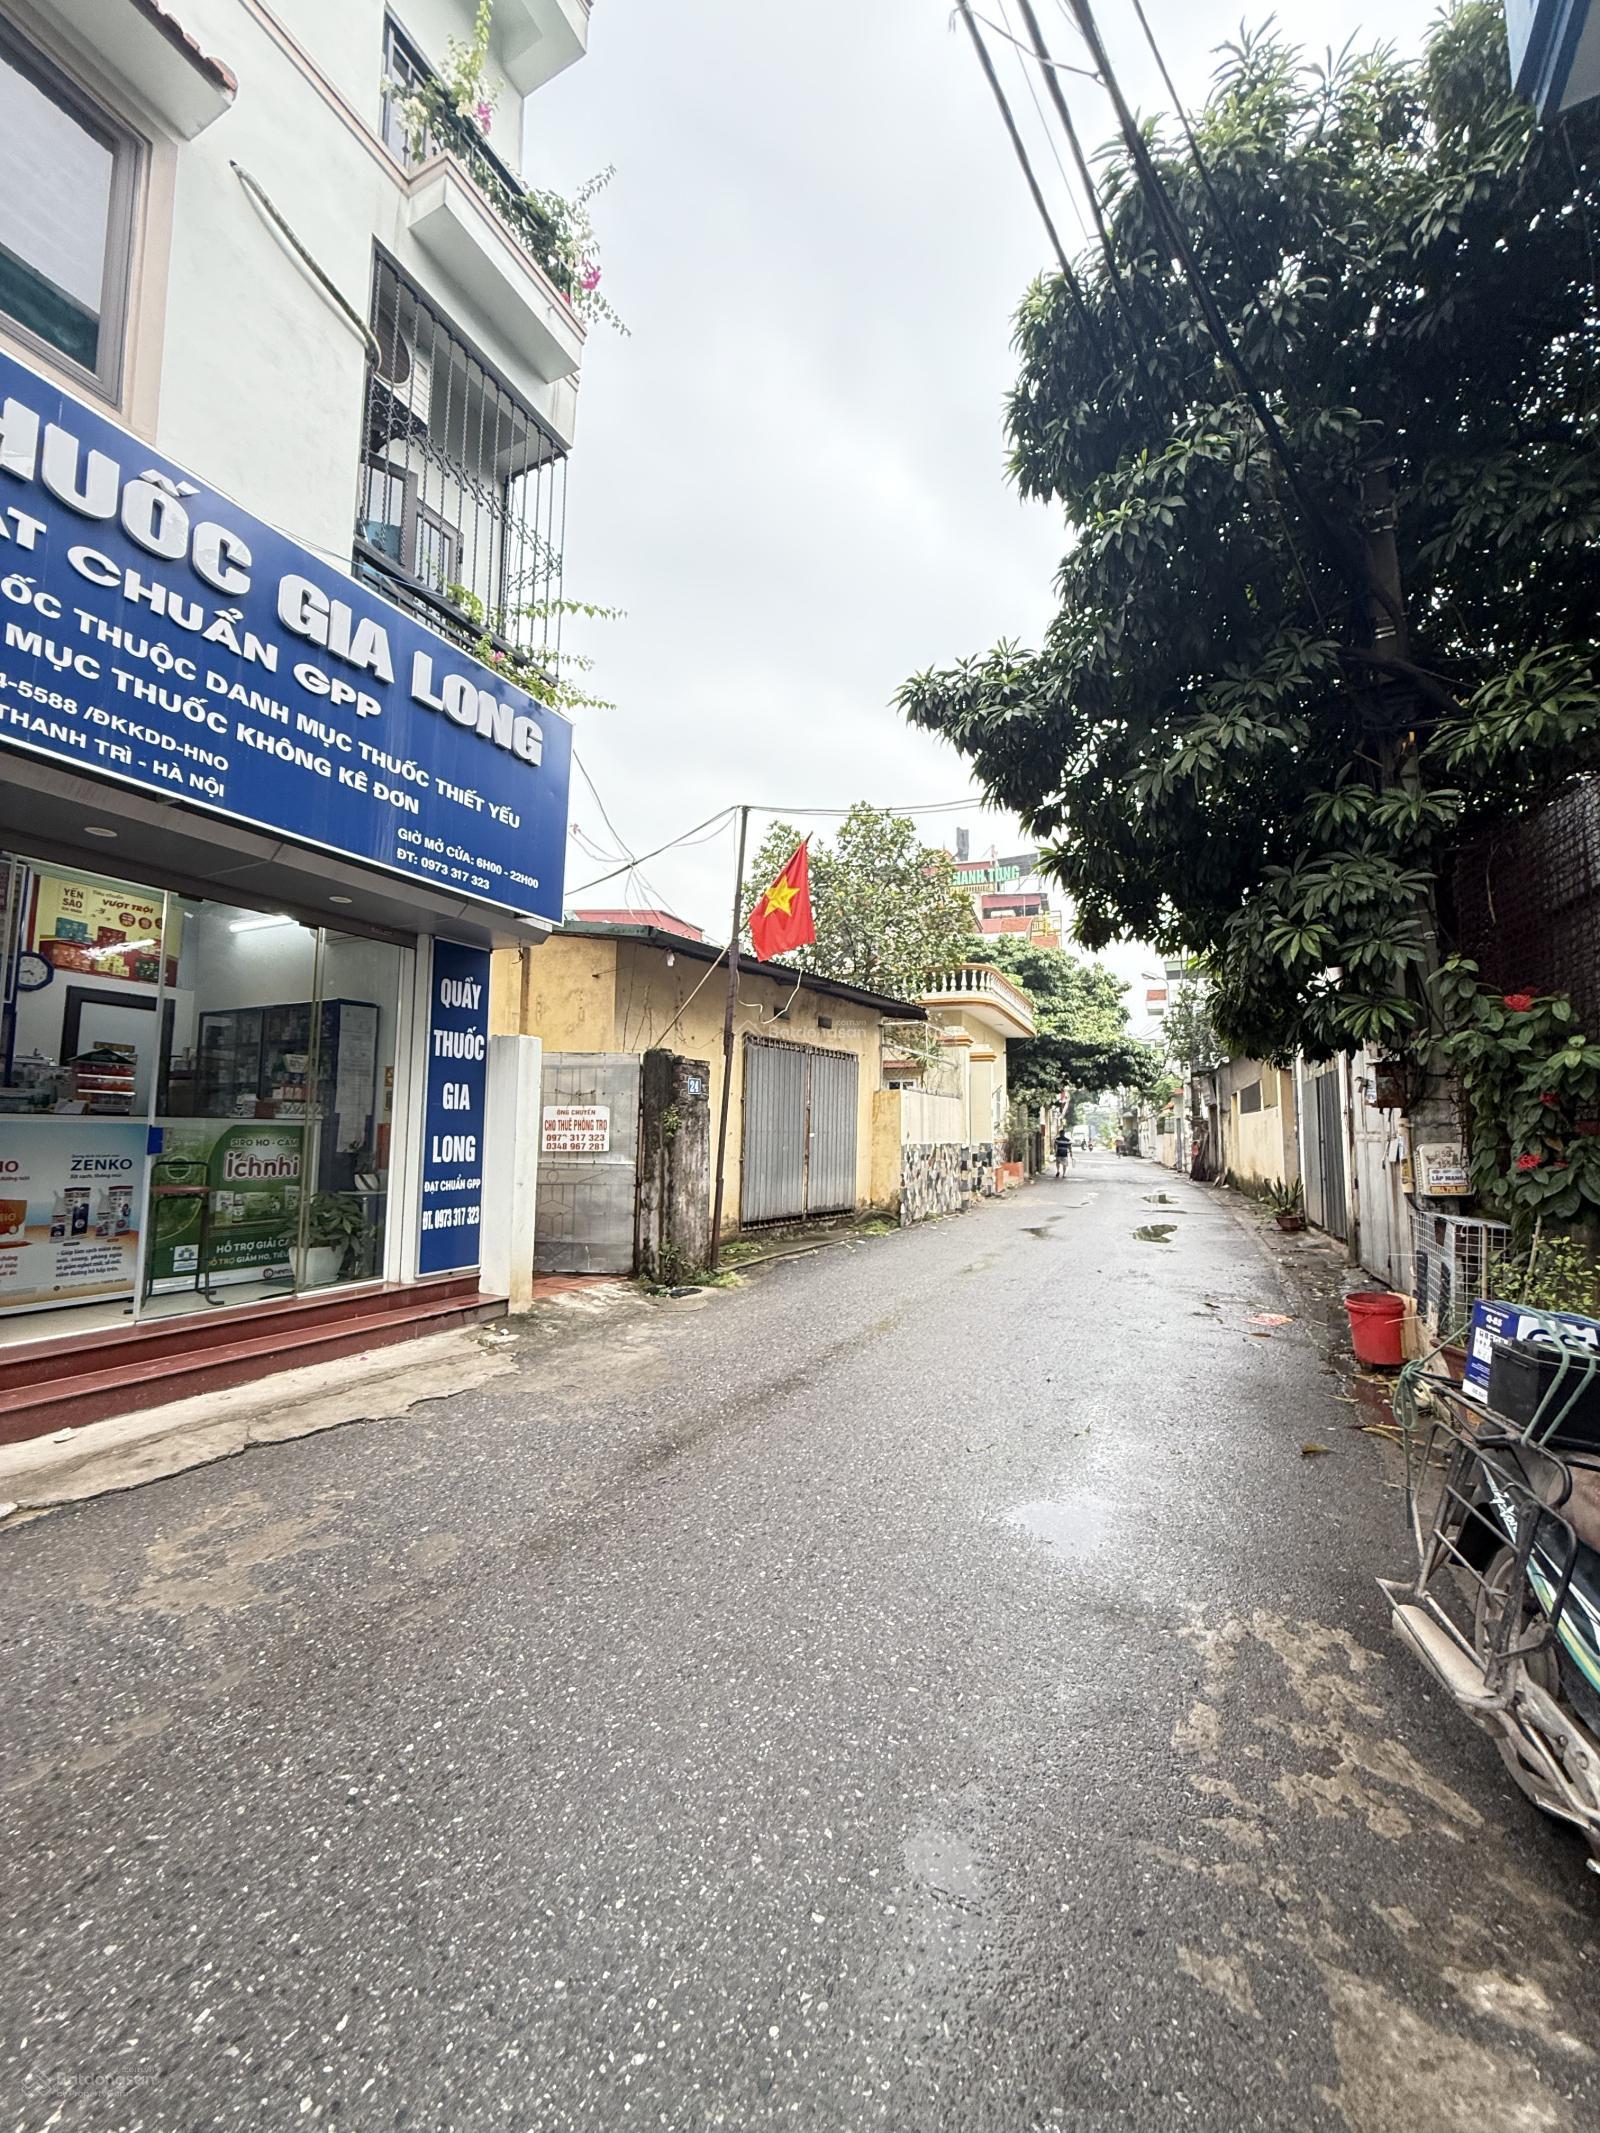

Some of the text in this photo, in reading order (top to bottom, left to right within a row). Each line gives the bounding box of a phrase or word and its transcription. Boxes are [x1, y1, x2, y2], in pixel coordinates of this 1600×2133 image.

[67, 546, 278, 672] CHUẨN
[293, 663, 381, 718] GPP
[278, 574, 394, 684] GIA
[411, 651, 543, 767] LONG
[5, 622, 419, 815] MỤC THUỐC KHÔNG KÊ ĐƠN
[73, 608, 196, 680] THUỘC
[206, 670, 289, 724] DANH
[297, 713, 352, 752] MỤC
[358, 741, 429, 787] THUỐC
[435, 778, 485, 812] THIẾT
[488, 803, 521, 829] YẾU
[94, 738, 132, 765] TRÌ
[152, 759, 183, 783] HÀ
[189, 777, 225, 797] NỘI
[396, 847, 490, 890] ĐT: 0973 317 323
[397, 828, 422, 845] GIỜ
[424, 837, 445, 853] MỞ
[476, 858, 502, 875] 6H00
[509, 870, 539, 889] 22H00
[440, 976, 482, 1010] QUẦY
[433, 1026, 485, 1061] THUỐC
[442, 1082, 471, 1110] GIA
[256, 1138, 270, 1147] HO
[544, 1119, 556, 1131] CHO
[596, 1119, 608, 1132] TRỌ
[70, 1159, 133, 1171] ZENKO
[432, 1135, 476, 1163] LONG
[424, 1181, 439, 1195] ĐẠT
[466, 1178, 481, 1189] GPP
[434, 1208, 452, 1229] 0973
[453, 1207, 466, 1226] 317
[466, 1205, 480, 1225] 323
